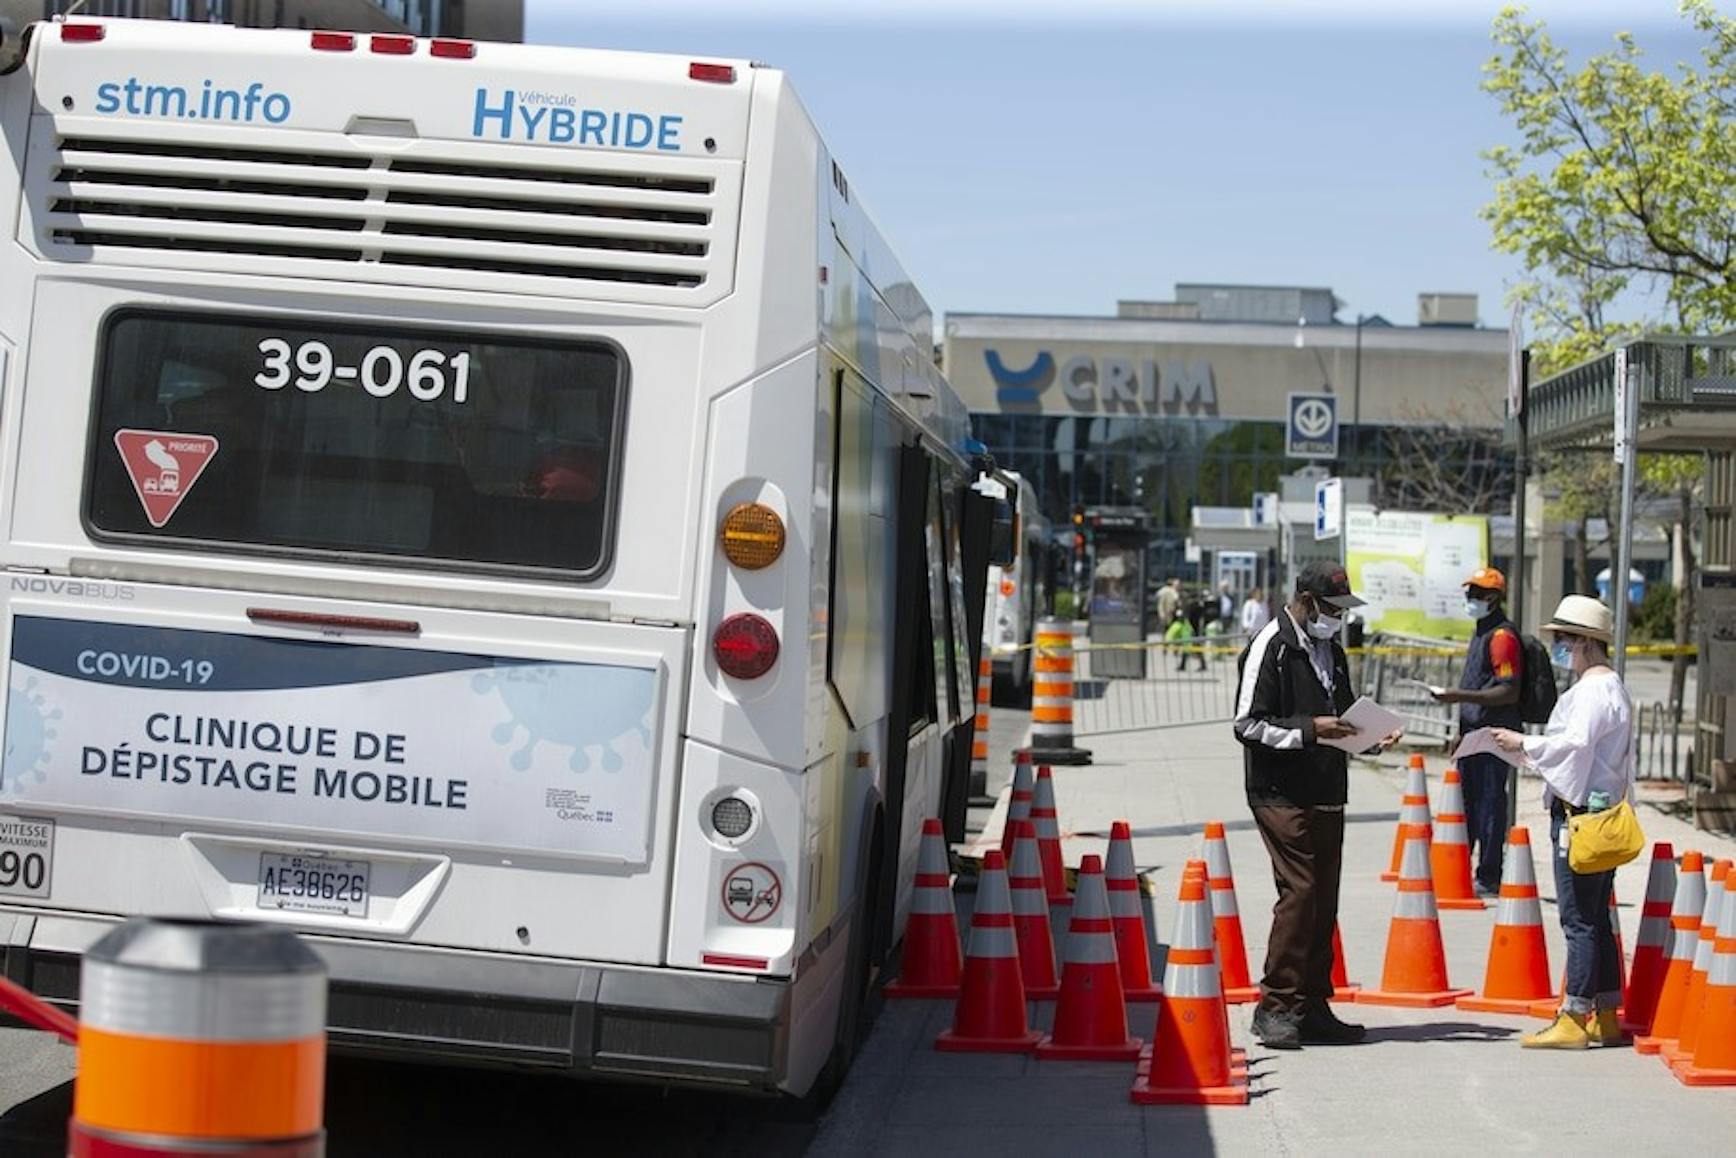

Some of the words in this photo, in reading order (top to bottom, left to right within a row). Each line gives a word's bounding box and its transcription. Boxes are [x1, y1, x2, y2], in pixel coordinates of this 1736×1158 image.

[96, 78, 292, 123] stm.info
[473, 88, 683, 150] HYBRIDE
[518, 90, 577, 107] Véhicule
[254, 337, 471, 404] 39-061
[1060, 354, 1216, 405] CRIM
[76, 650, 214, 685] COVID-19
[144, 712, 337, 757] CLINIQUE
[353, 730, 407, 764] DE
[81, 742, 298, 795] DÉPISTAGE
[313, 766, 469, 810] MOBILE
[0, 822, 48, 838] VITESSE
[556, 809, 595, 821] Québec
[0, 850, 45, 890] 90
[263, 866, 365, 903] AE38626
